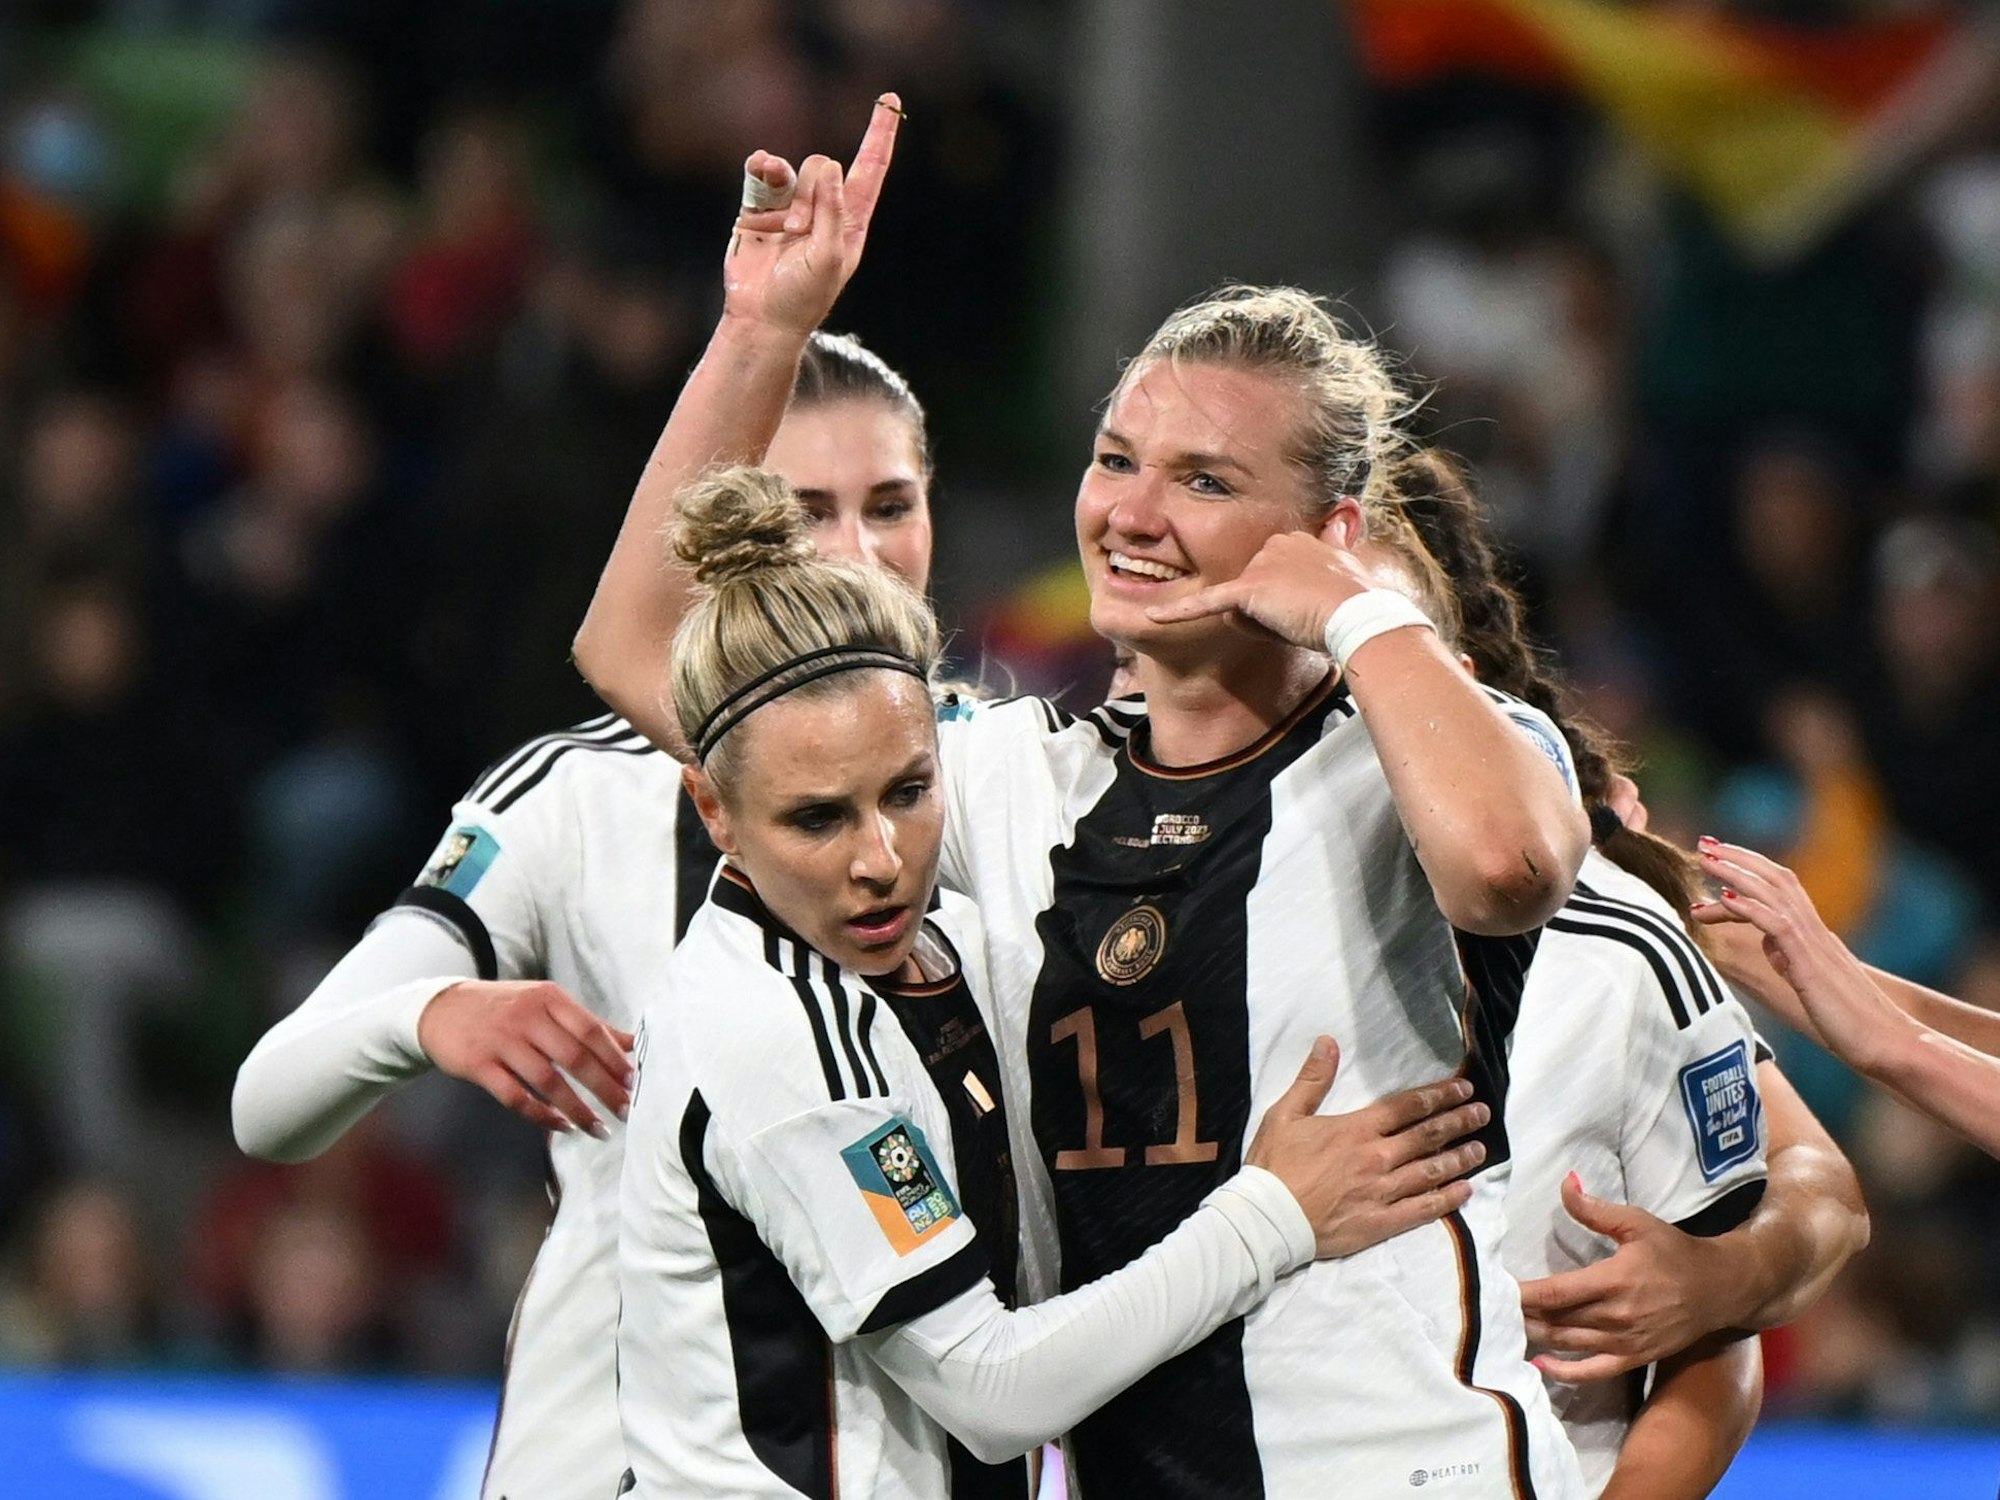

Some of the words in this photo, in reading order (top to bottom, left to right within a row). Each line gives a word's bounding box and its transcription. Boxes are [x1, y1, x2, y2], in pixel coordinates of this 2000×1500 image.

[1160, 824, 1183, 834] JULY
[1050, 1000, 1219, 1171] 11
[1701, 1064, 1744, 1095] FOOTBALL
[1706, 1080, 1745, 1116] UNITES
[1721, 1130, 1740, 1146] FIFA
